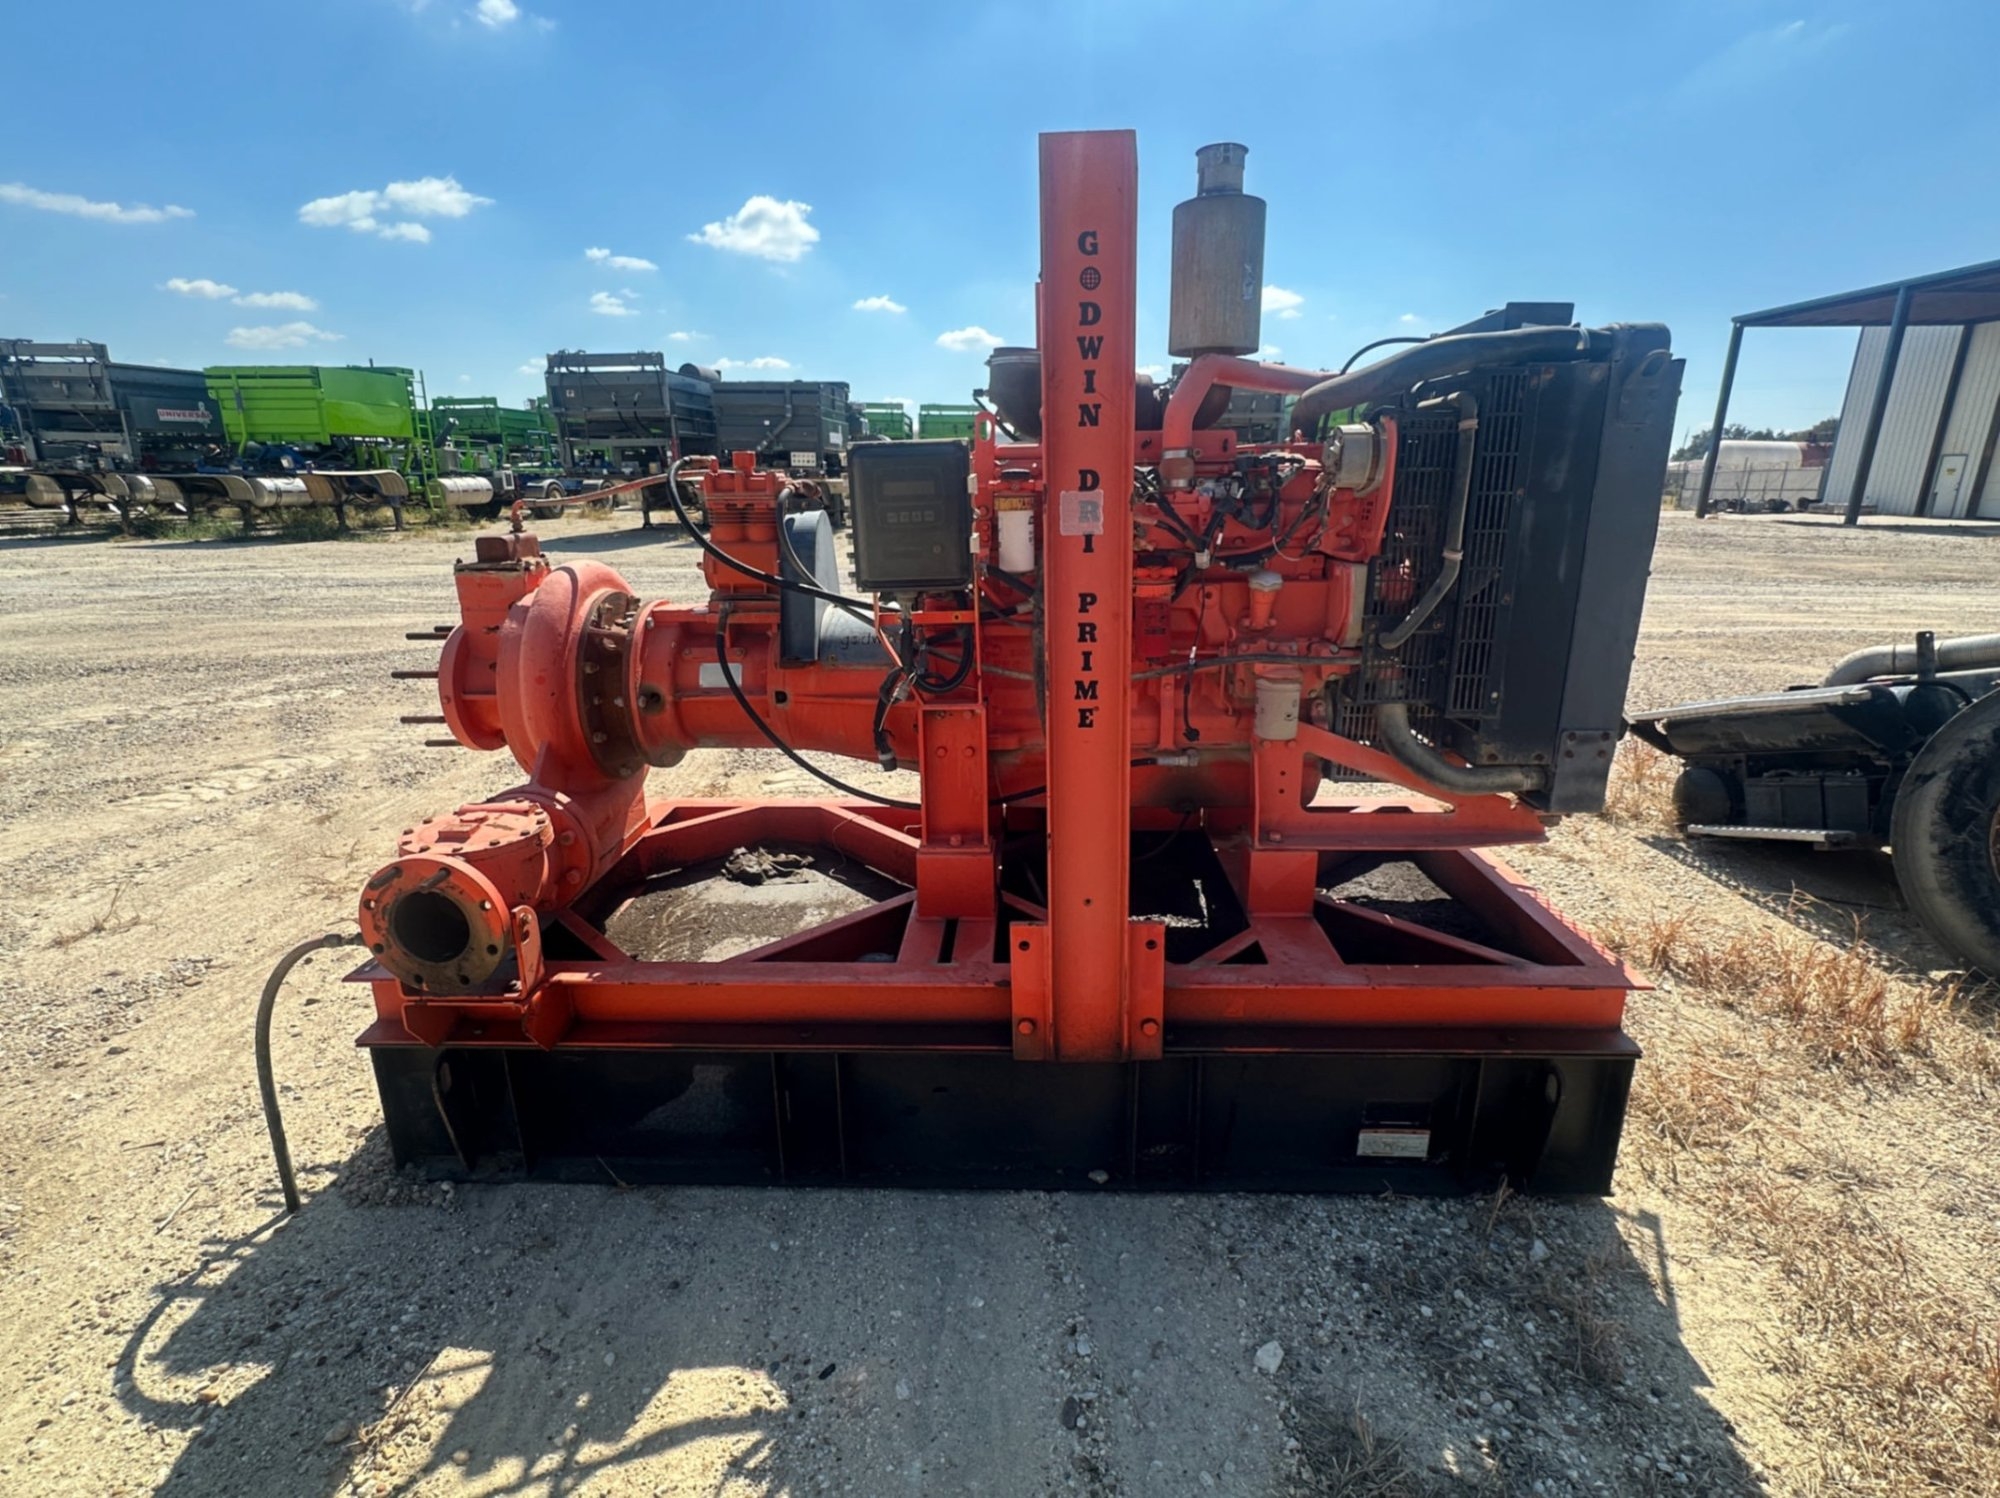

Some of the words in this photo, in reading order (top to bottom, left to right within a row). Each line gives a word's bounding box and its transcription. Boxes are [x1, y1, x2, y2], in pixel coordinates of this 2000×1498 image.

[1077, 231, 1103, 427] GODWIN
[1078, 469, 1100, 553] DRI
[1074, 593, 1098, 728] PRIME
